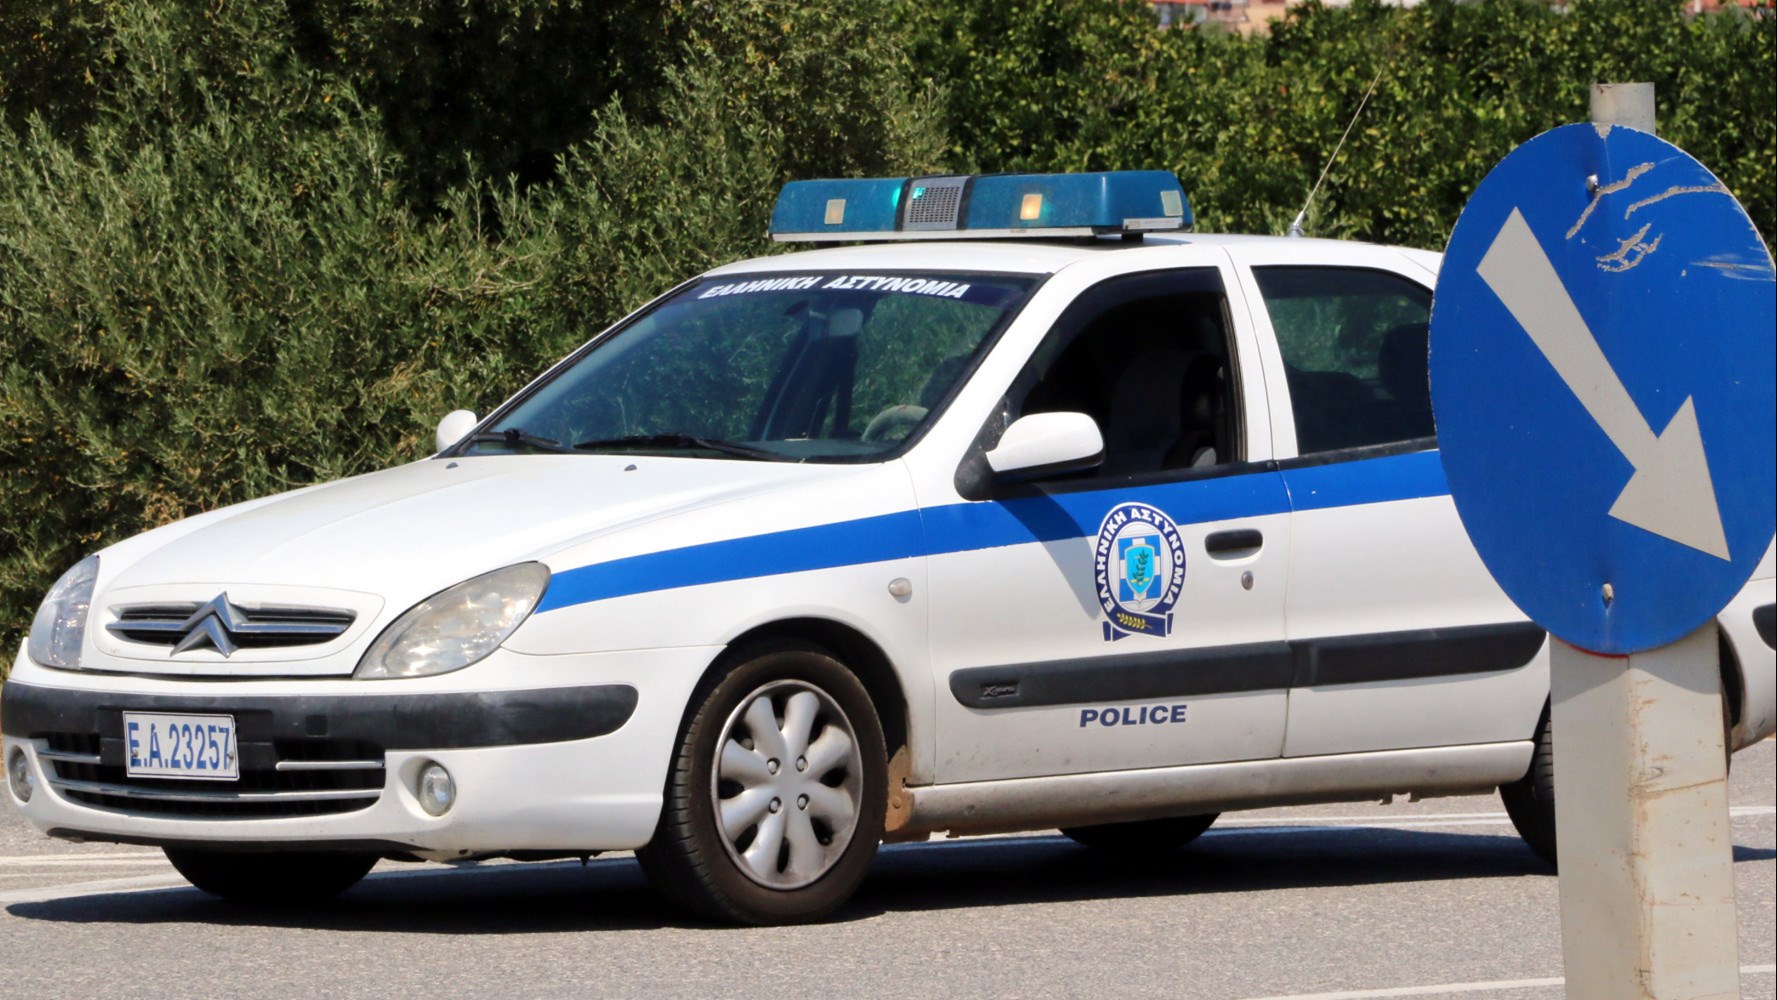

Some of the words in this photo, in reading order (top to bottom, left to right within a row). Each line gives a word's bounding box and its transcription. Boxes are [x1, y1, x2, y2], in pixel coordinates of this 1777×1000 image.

[698, 276, 823, 300] ΕΛΛΗΝΙΚΗ
[824, 275, 971, 299] ΑΣΤΥΝΟΜΙΑ
[1096, 511, 1127, 613] ΕΛΛΗΝΙΚΗ
[1130, 508, 1184, 605] ΑΣΤΥΝΟΜΙΑ
[1079, 704, 1187, 728] POLICE
